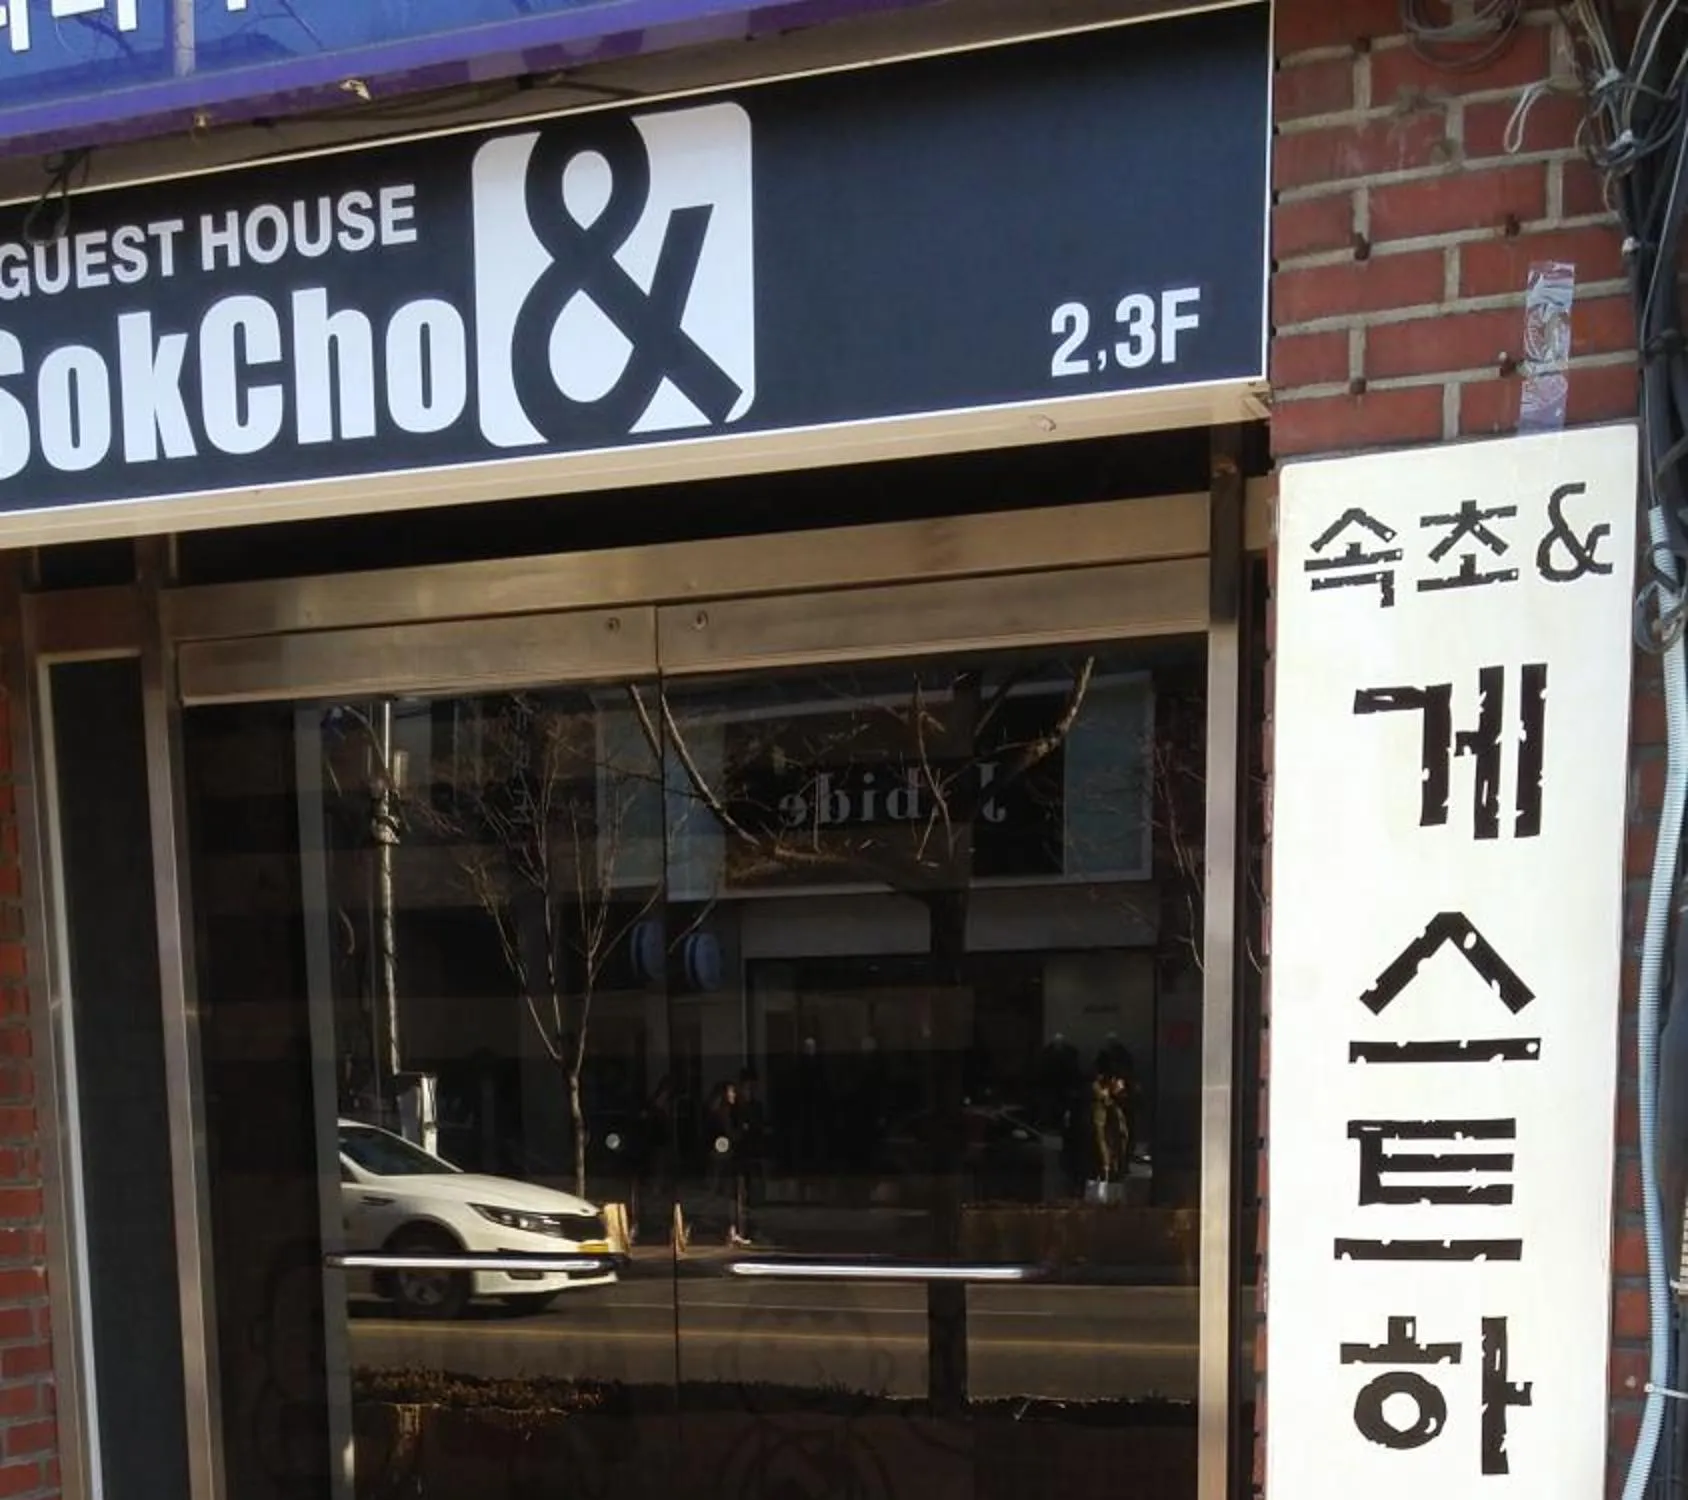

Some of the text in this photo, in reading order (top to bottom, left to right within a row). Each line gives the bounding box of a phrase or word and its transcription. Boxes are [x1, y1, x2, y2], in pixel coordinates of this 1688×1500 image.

[0, 184, 417, 301] GUEST HOUSE
[1050, 287, 1201, 378] 2,3F
